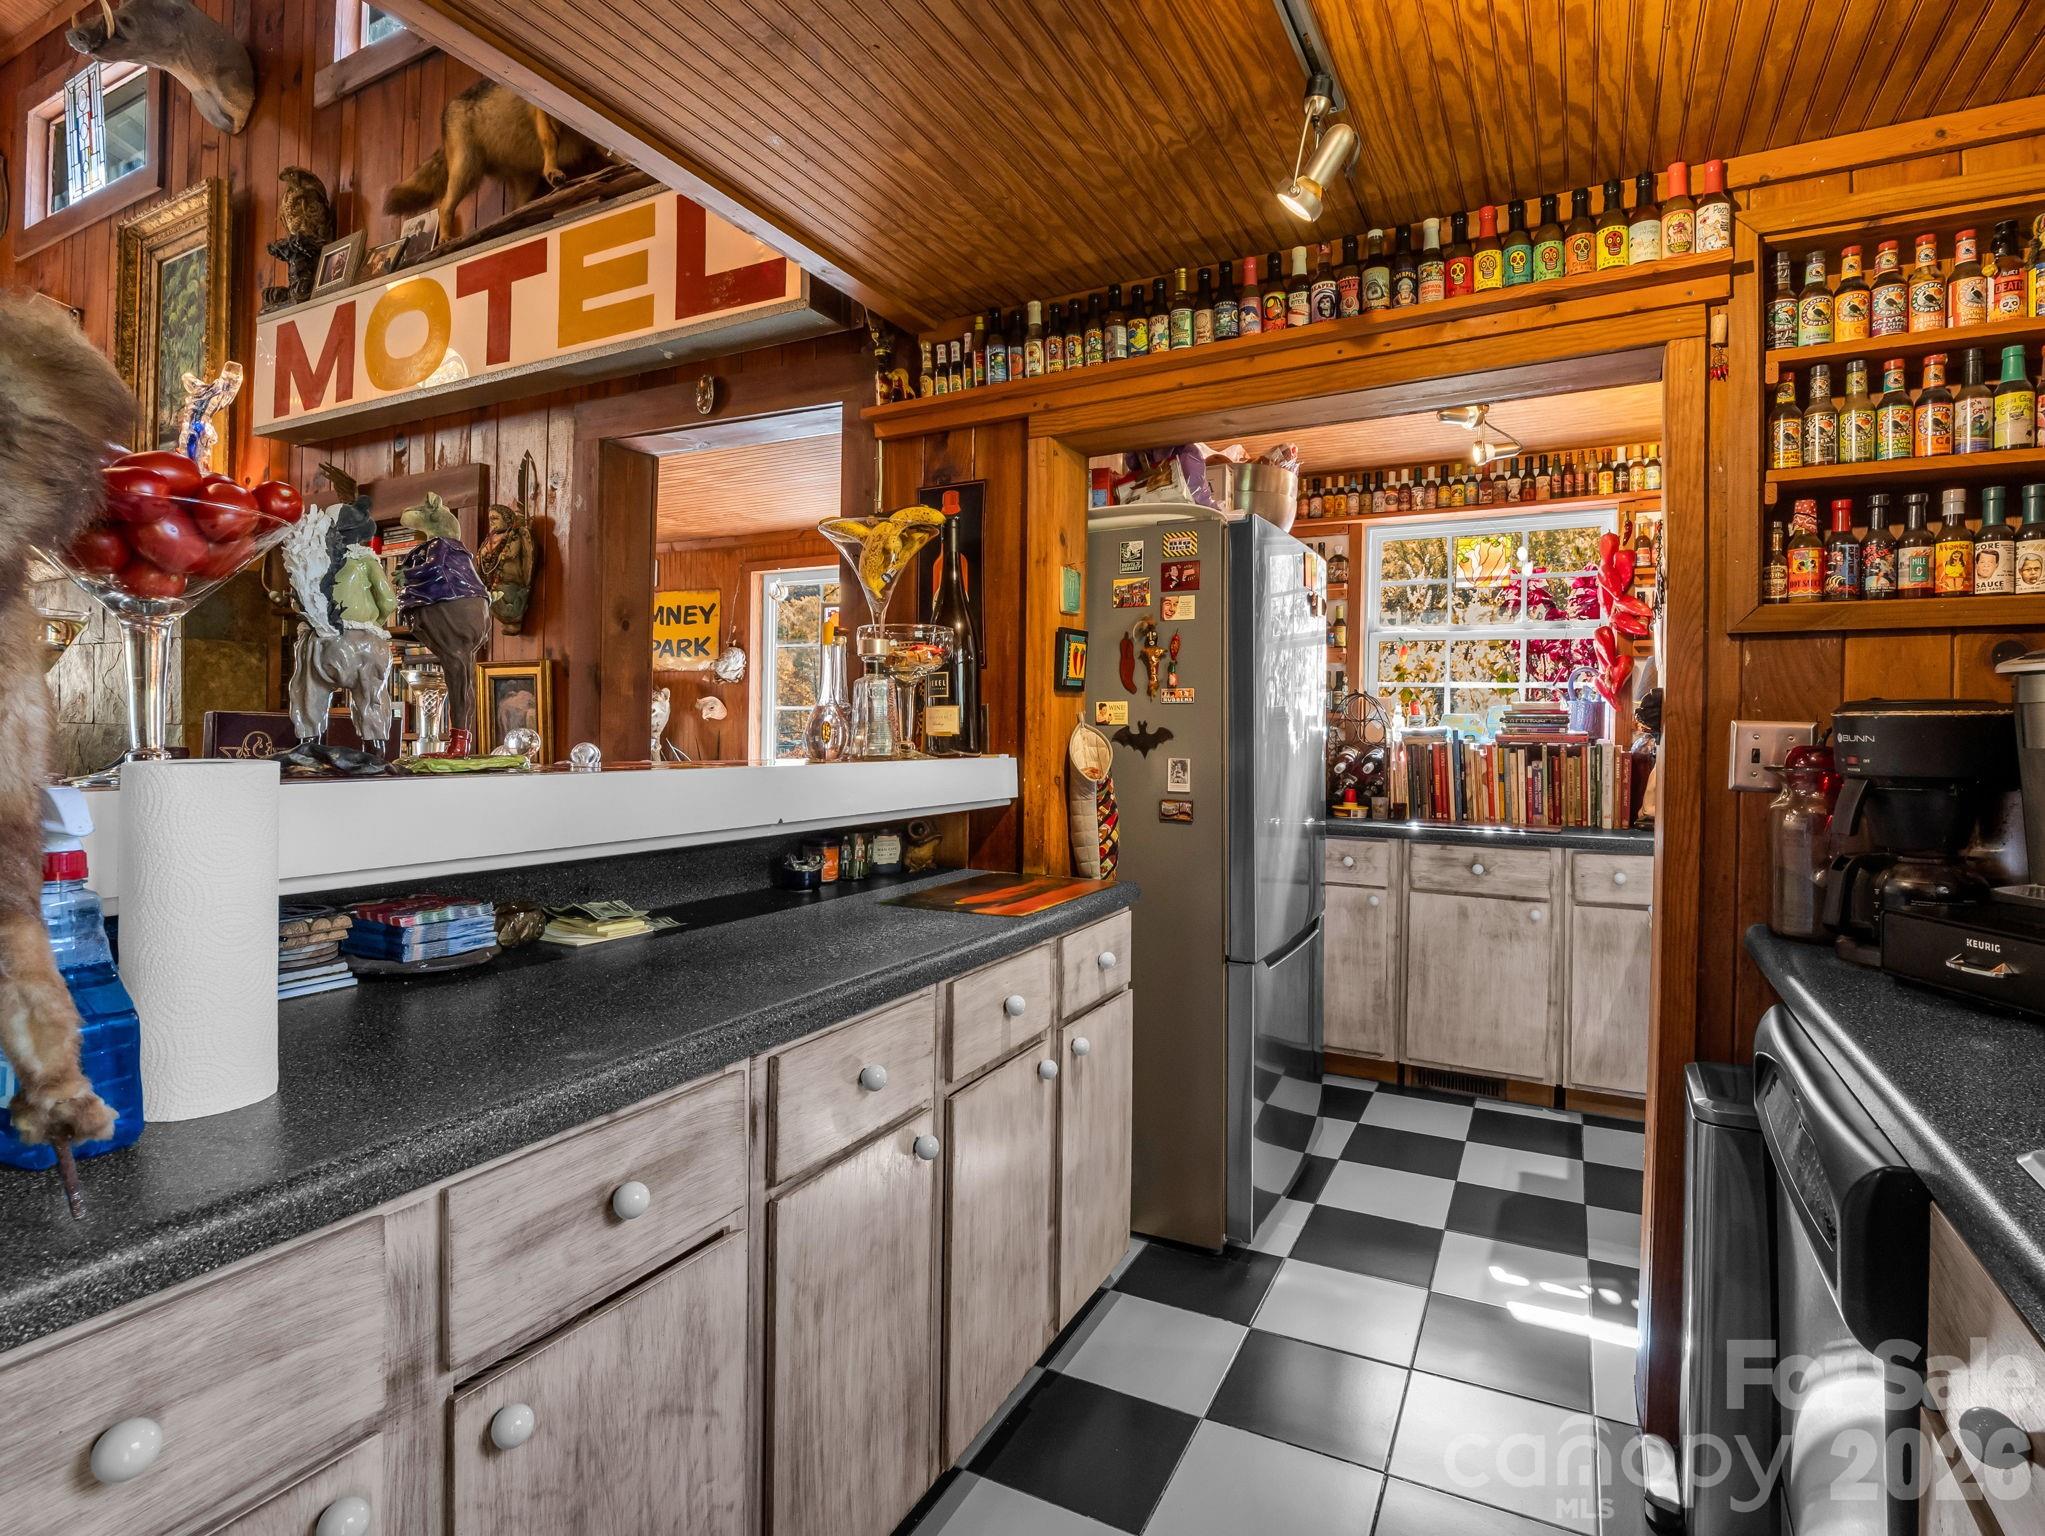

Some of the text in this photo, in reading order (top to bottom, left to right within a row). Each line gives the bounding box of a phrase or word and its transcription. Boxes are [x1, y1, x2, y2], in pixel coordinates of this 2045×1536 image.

[1996, 280, 2023, 293] DEATH
[273, 193, 787, 419] MOTEL
[1975, 542, 2000, 552] GORE
[1912, 557, 1926, 565] MILE
[1976, 580, 2004, 589] SAUCE
[653, 636, 712, 658] PARK
[1842, 734, 1875, 743] BUNN
[1966, 938, 2001, 953] KEURIG
